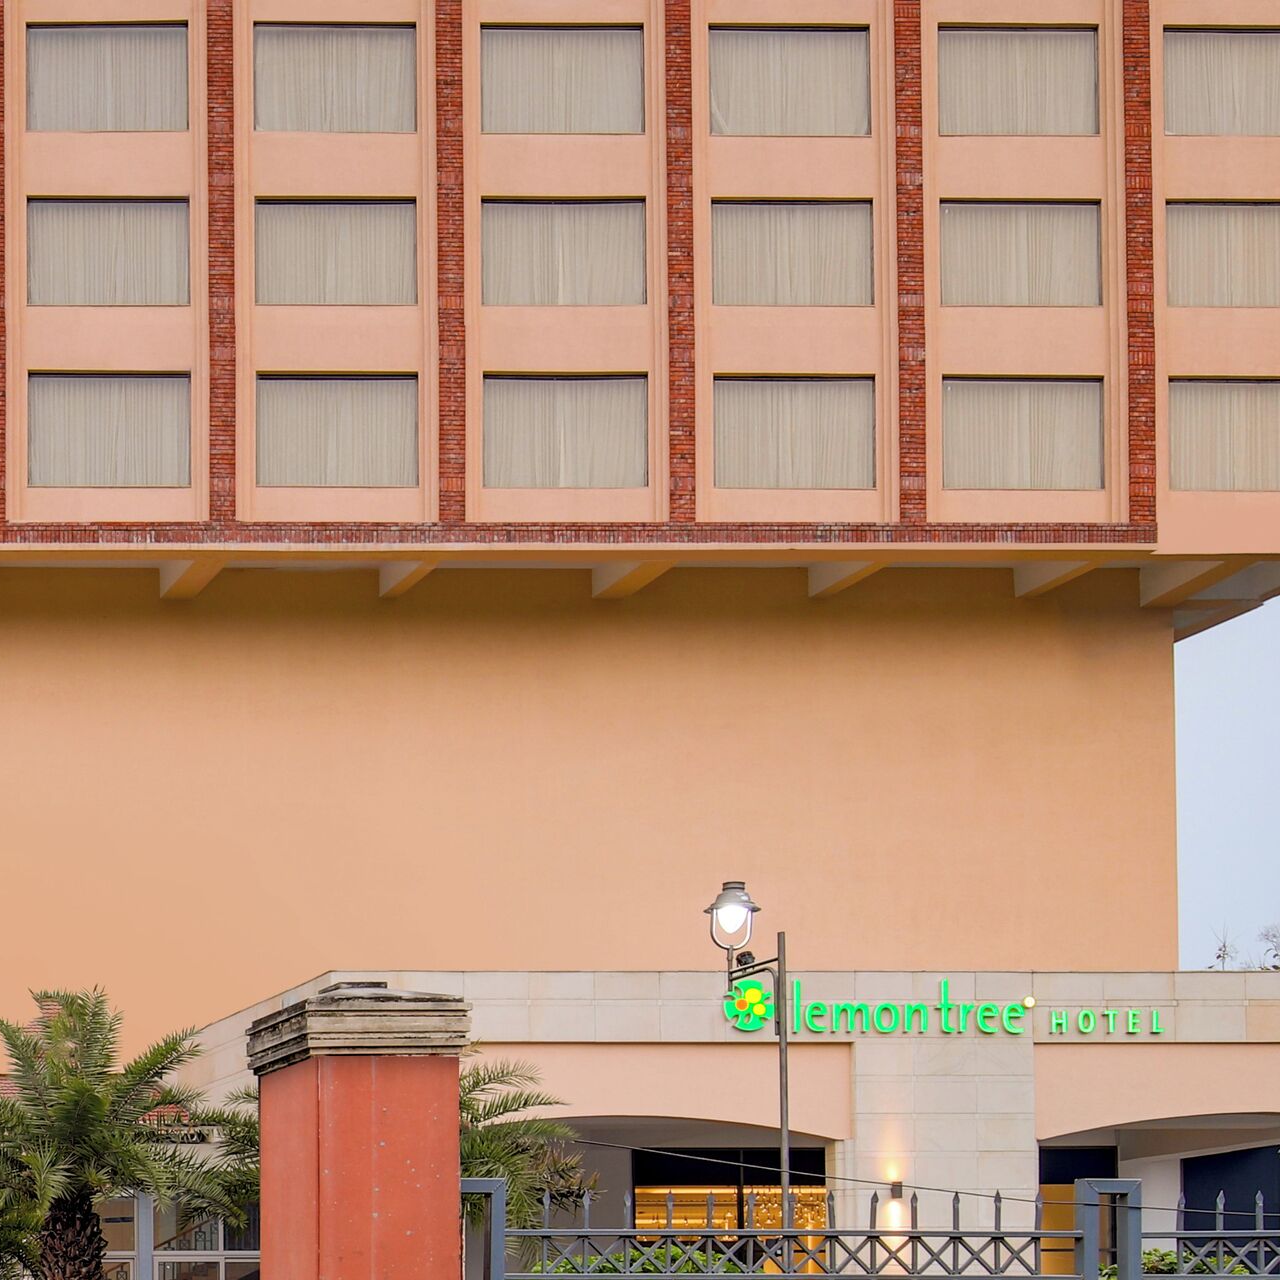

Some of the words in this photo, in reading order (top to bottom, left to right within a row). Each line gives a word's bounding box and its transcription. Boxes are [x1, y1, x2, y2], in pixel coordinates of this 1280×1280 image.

[792, 978, 929, 1034] lemon
[936, 977, 1025, 1034] tree
[1049, 1009, 1165, 1034] HOTEL
